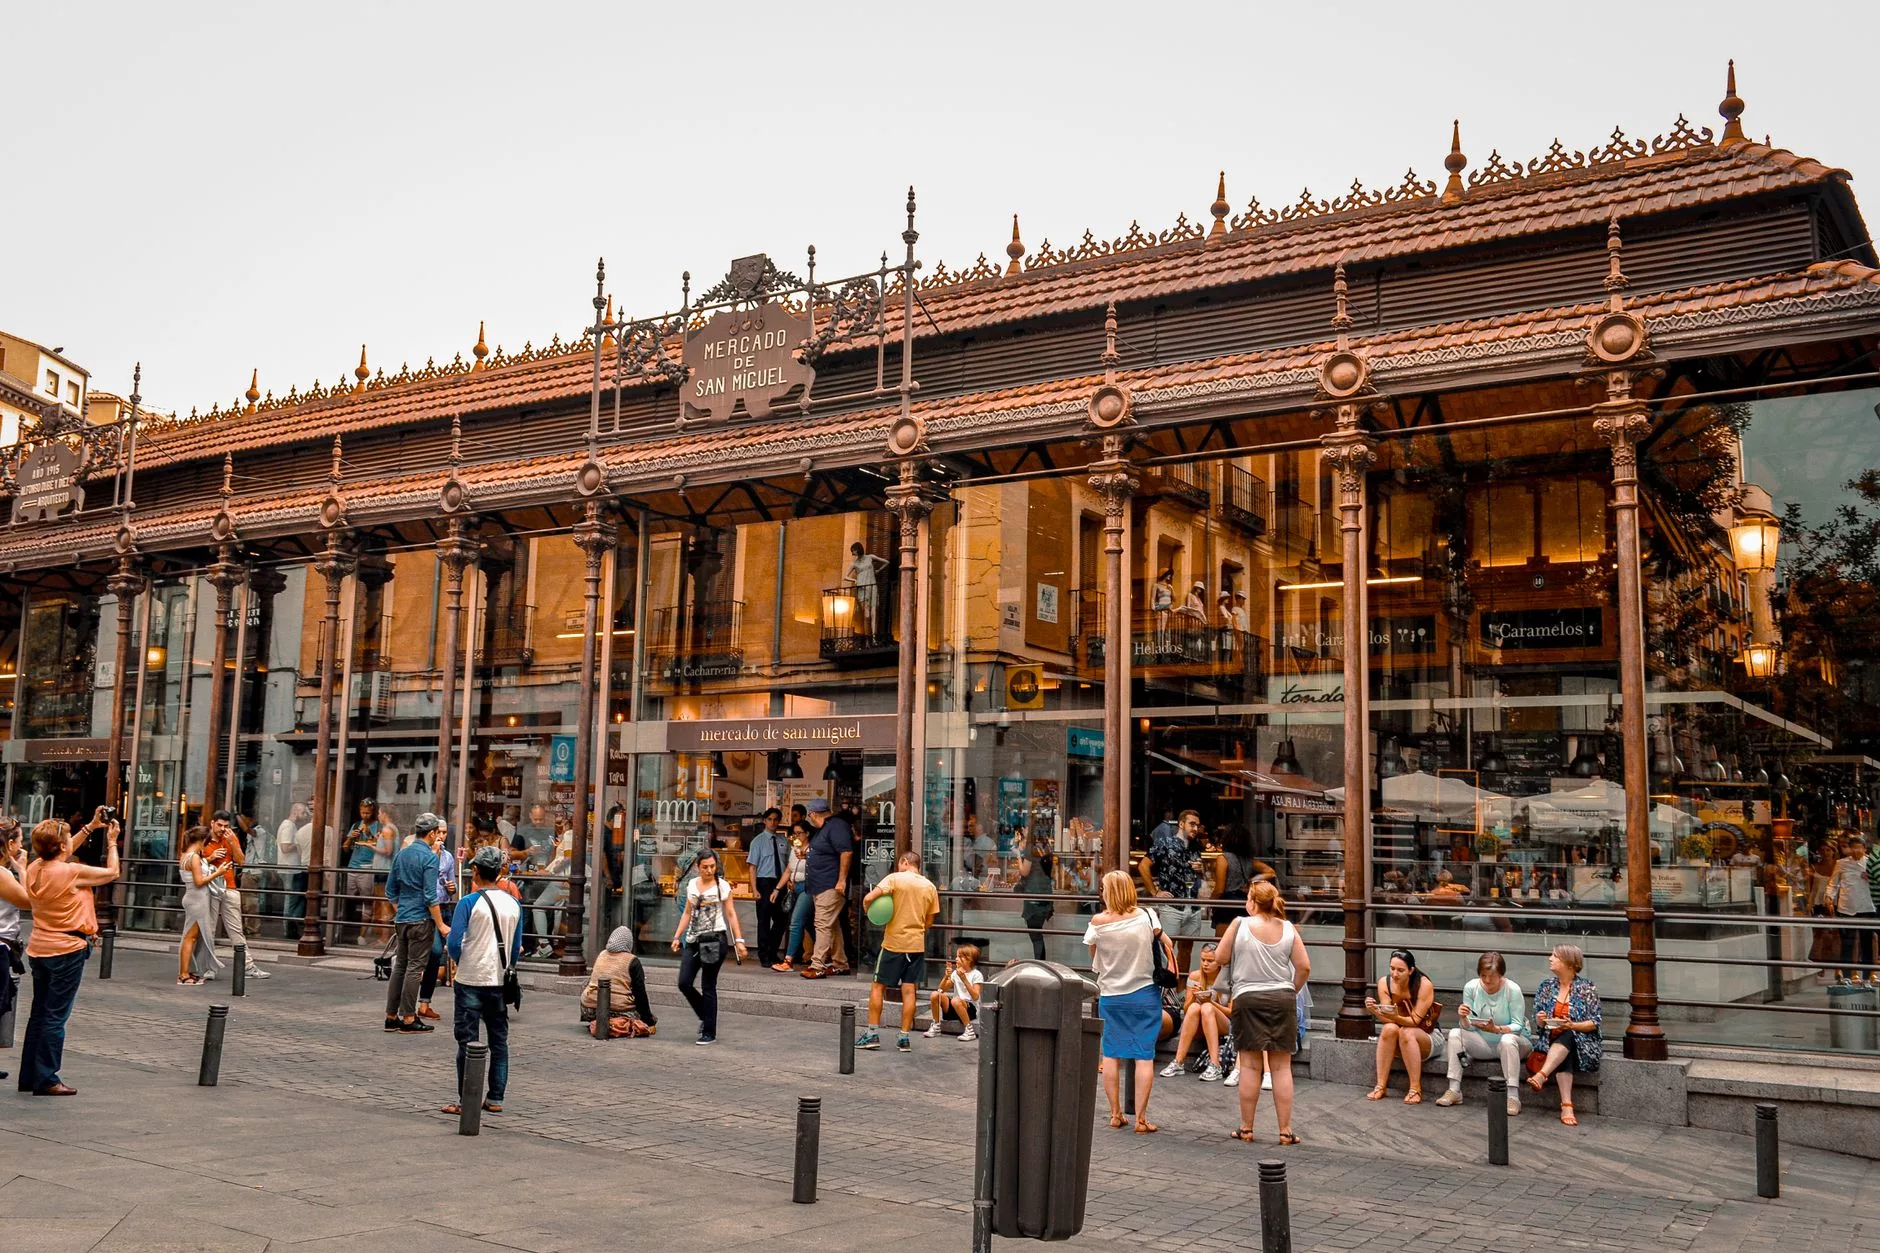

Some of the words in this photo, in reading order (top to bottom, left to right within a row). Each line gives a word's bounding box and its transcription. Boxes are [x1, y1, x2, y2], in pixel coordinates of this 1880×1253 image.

[704, 329, 786, 360] MERCADO
[733, 355, 755, 370] DE
[695, 376, 725, 397] SAN
[46, 463, 61, 476] 1915
[1499, 621, 1583, 638] Caramelos
[1315, 630, 1391, 647] Caralos
[1134, 640, 1183, 656] Helados
[700, 723, 759, 741] mercado
[762, 723, 780, 740] de
[782, 728, 808, 740] san
[811, 721, 861, 745] miguel
